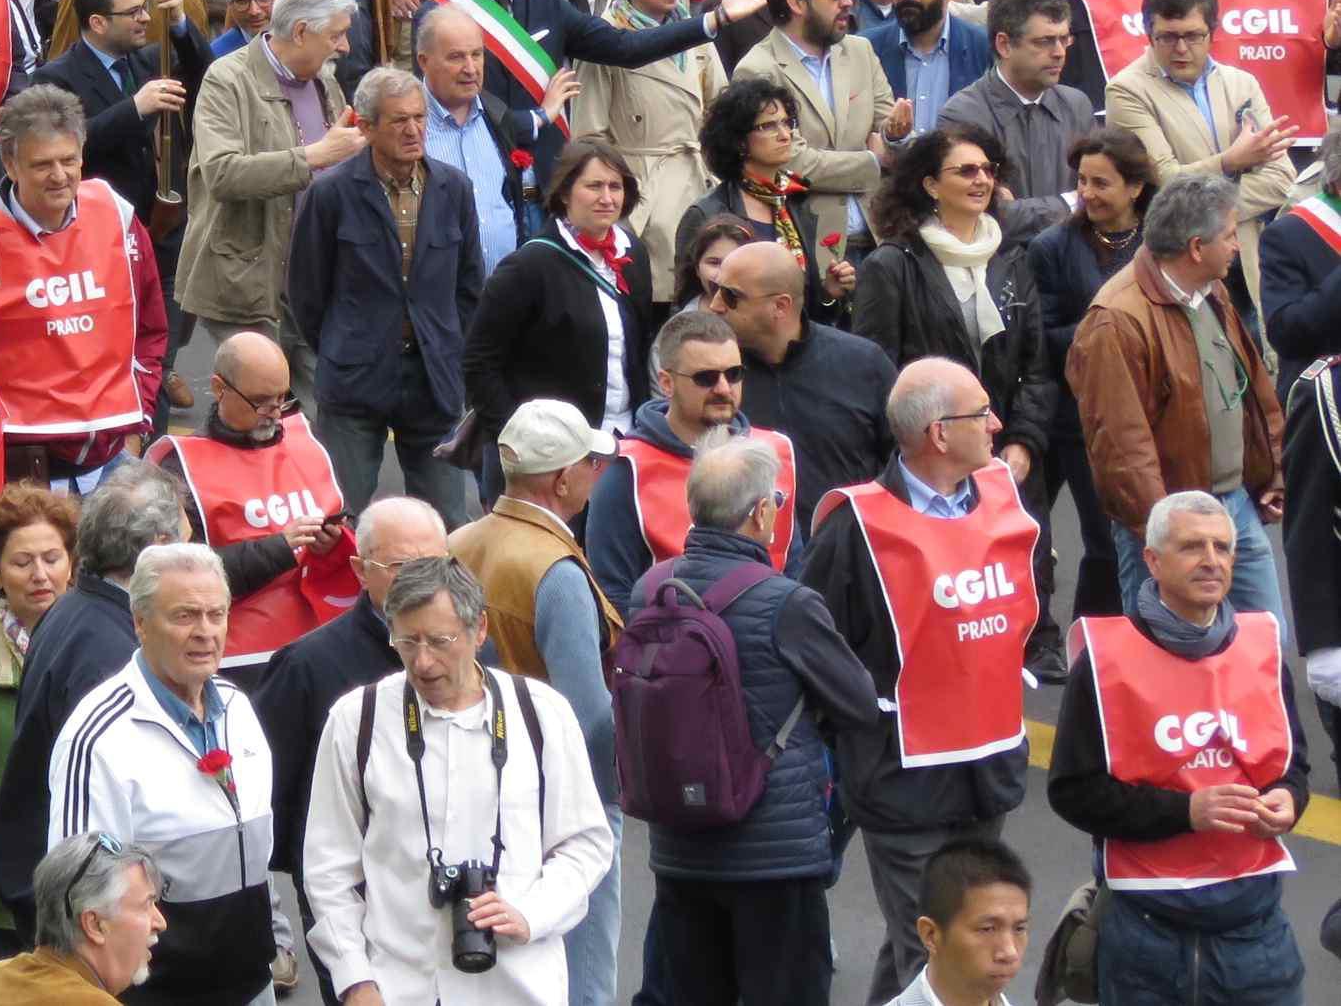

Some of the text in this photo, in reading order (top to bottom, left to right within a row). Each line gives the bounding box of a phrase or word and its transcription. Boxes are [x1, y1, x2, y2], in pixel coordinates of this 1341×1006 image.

[1221, 7, 1299, 35] CGIL
[1238, 44, 1286, 61] PRATO
[25, 270, 106, 309] CGIL
[46, 314, 94, 337] PRATO
[245, 488, 324, 528] CGIL
[934, 562, 1015, 610] CGIL
[957, 613, 1008, 642] PRATO
[496, 709, 505, 738] Nikon
